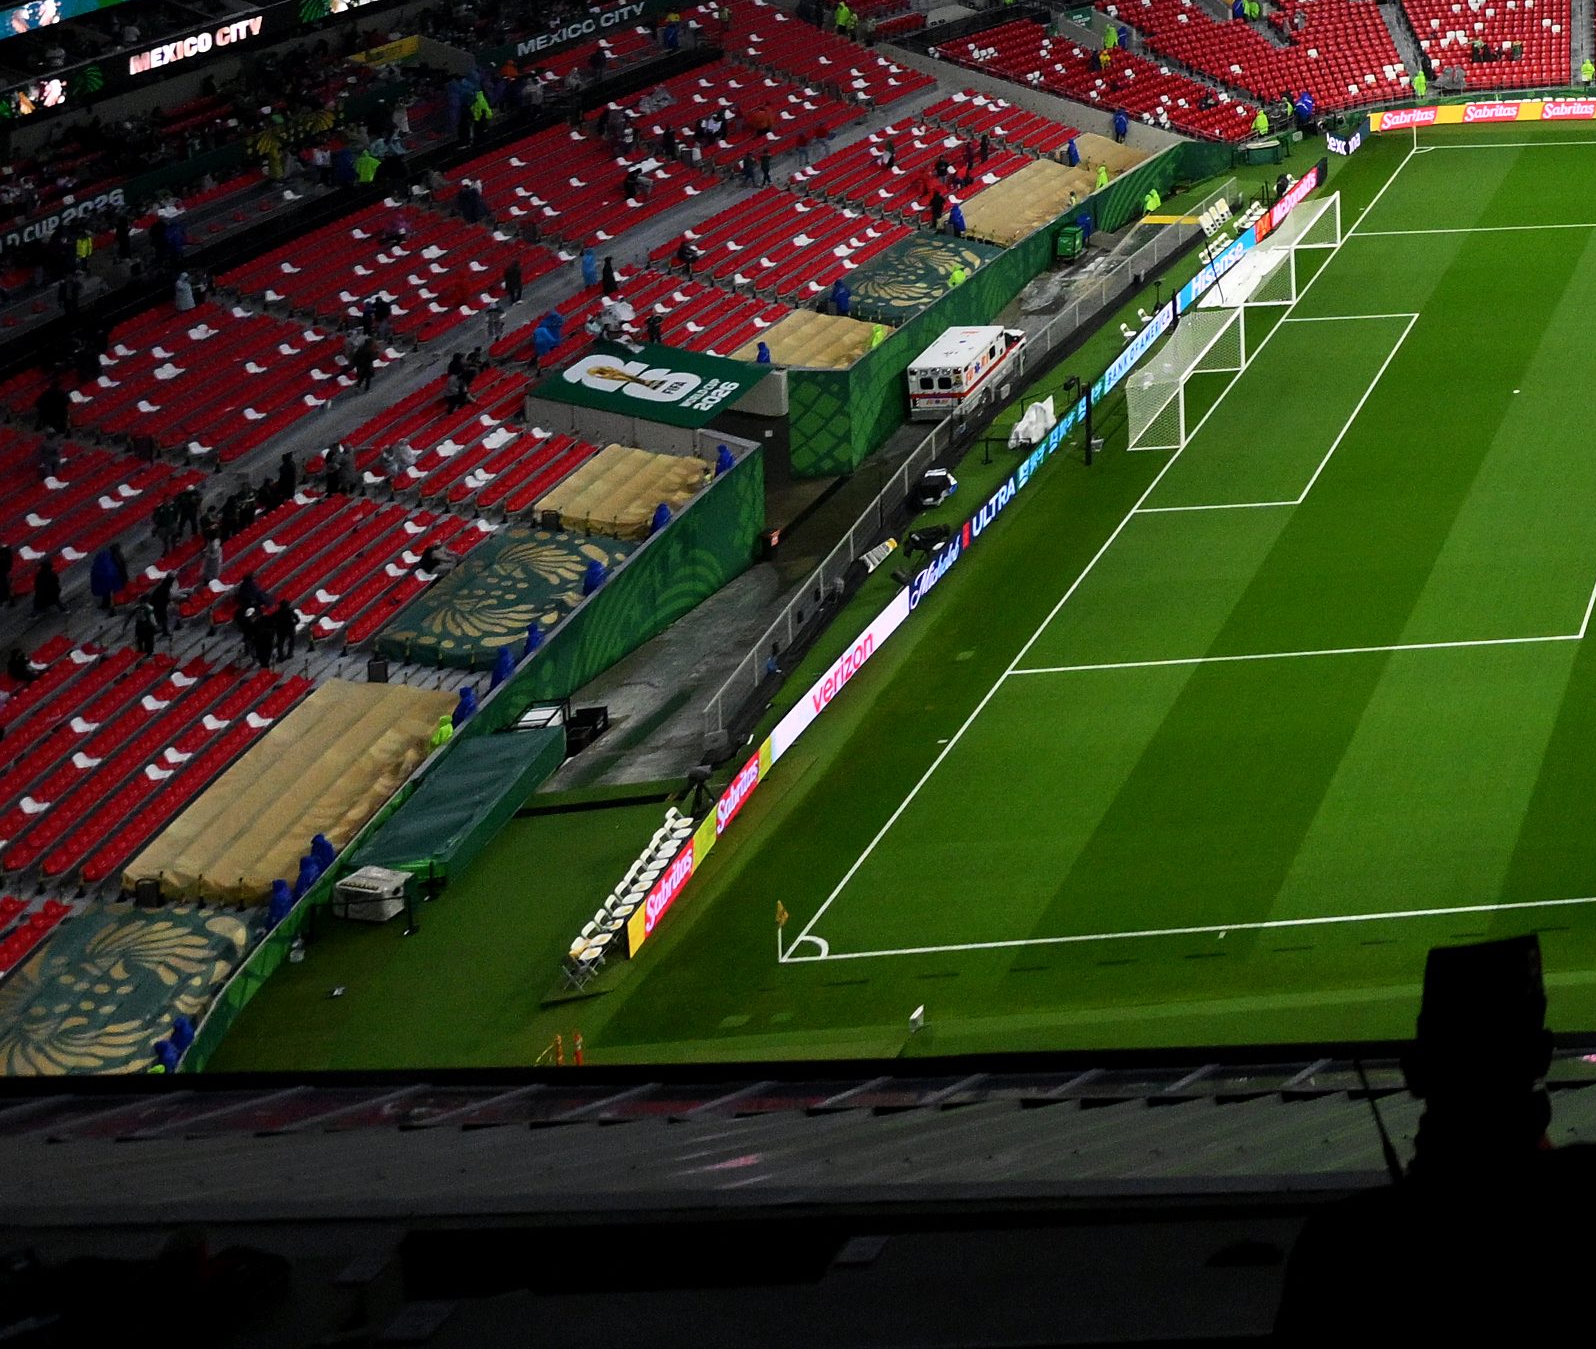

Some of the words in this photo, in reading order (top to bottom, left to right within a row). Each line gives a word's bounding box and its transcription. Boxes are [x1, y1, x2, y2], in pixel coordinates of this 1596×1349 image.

[129, 32, 213, 75] MEXICO
[215, 16, 263, 46] CITY
[517, 19, 595, 56] MEXICO
[600, 2, 645, 27] CITY
[1382, 109, 1435, 128] Sabritas
[1464, 106, 1517, 122] Sabritas
[1542, 104, 1594, 119] Sabritas
[1271, 170, 1318, 228] McDonald's
[1190, 242, 1244, 301] Hisense
[662, 381, 688, 395] FIFA
[1107, 354, 1128, 385] BANK
[1130, 342, 1139, 362] OF
[693, 381, 740, 411] 2026
[910, 536, 961, 610] Michelob
[971, 475, 1016, 536] ULTRA
[813, 633, 873, 712] verizon
[716, 760, 758, 834] Sabritas
[646, 847, 693, 932] Sabritas
